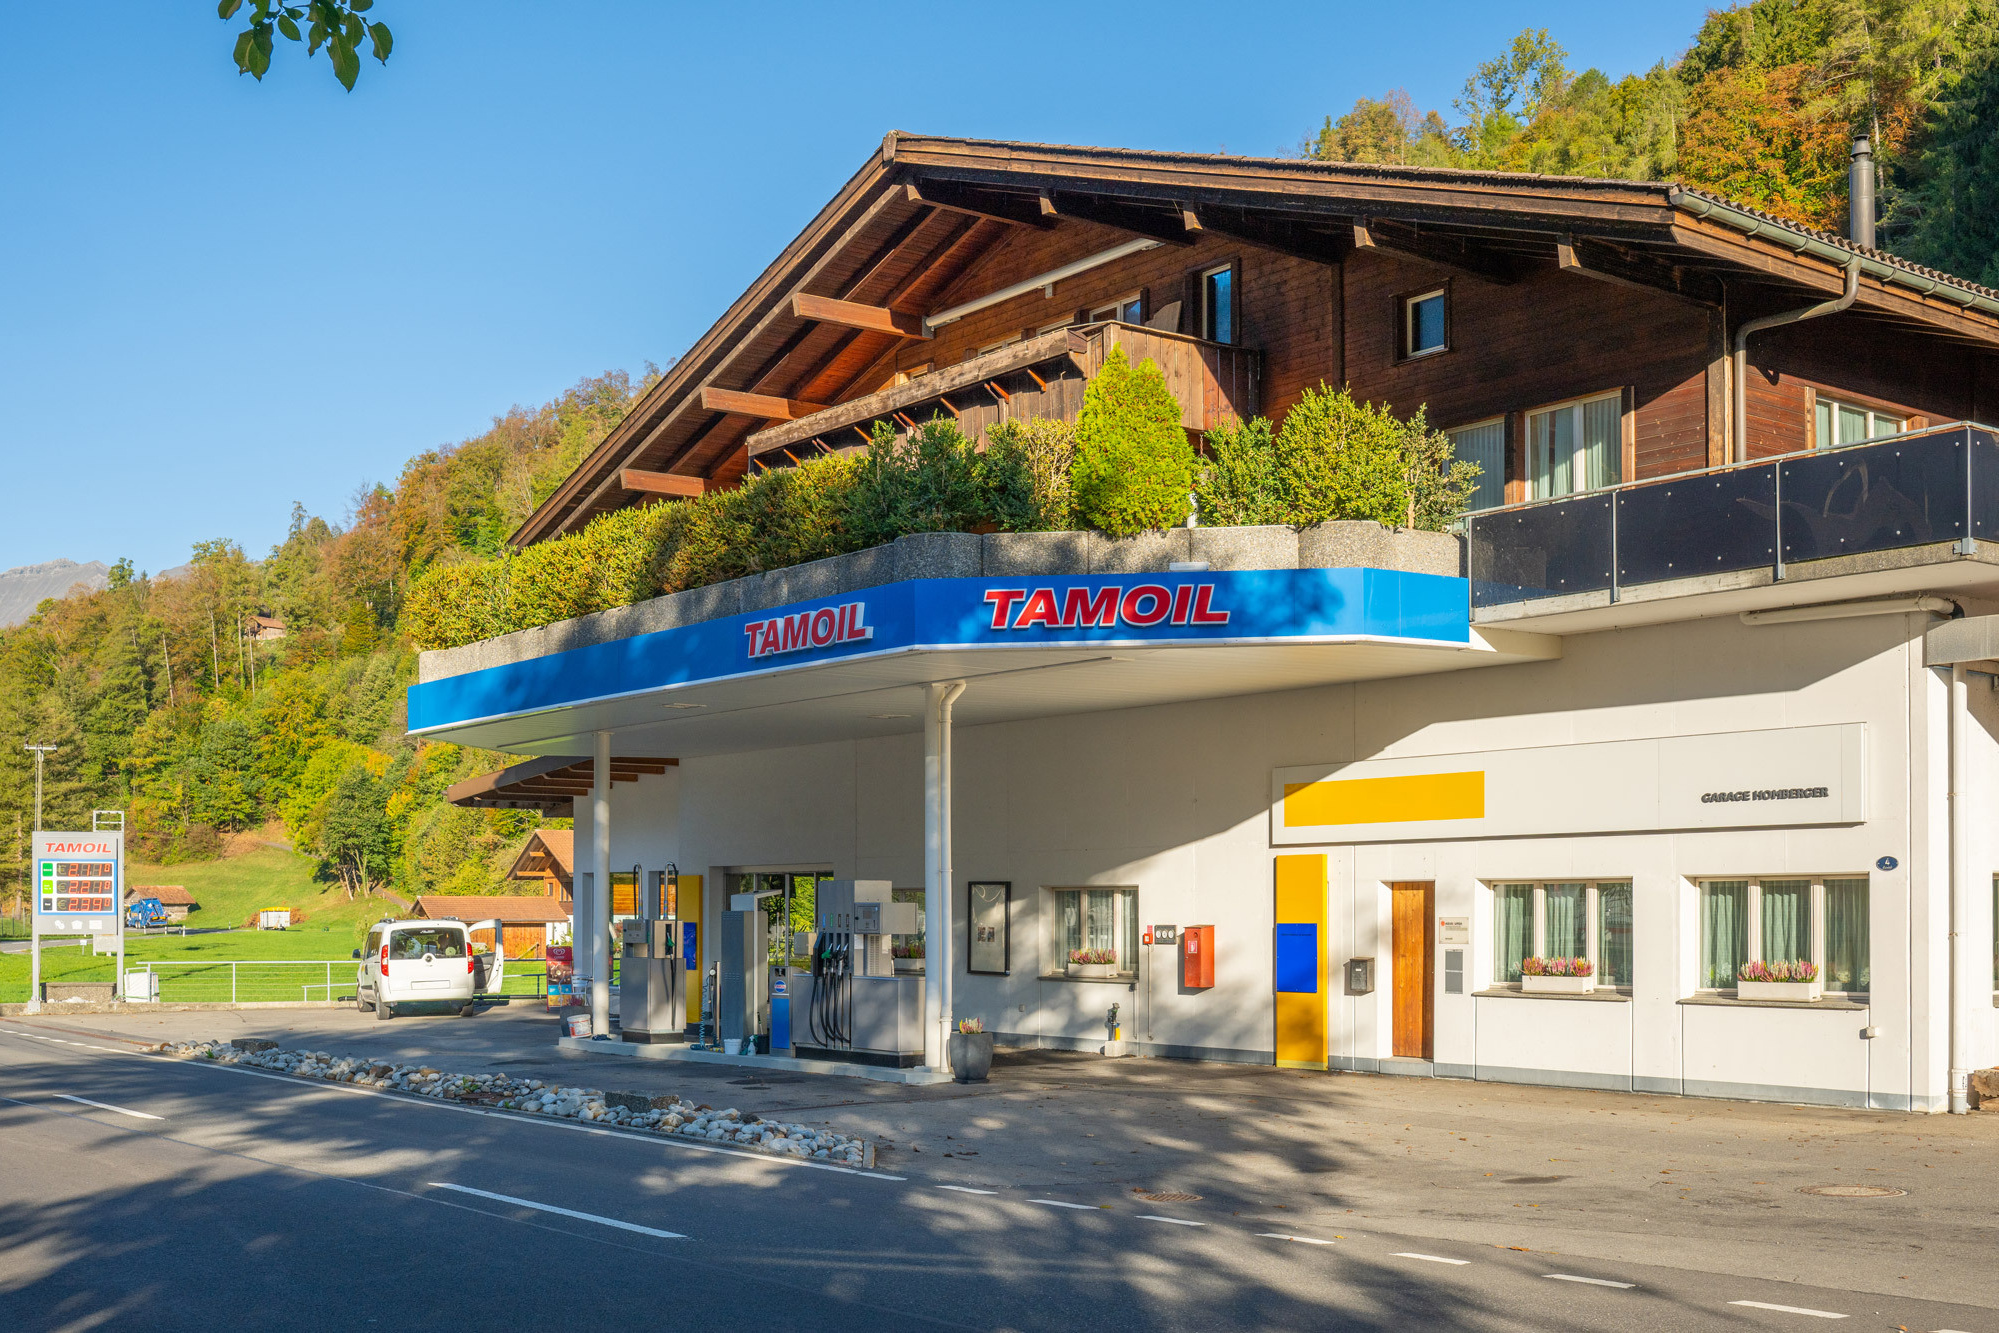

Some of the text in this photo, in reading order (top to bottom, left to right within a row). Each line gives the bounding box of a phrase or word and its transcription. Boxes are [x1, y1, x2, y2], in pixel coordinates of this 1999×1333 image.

[983, 584, 1230, 629] TAMOIL
[744, 602, 873, 658] TAMOIL
[1701, 787, 1829, 803] GARAGE HOMBERGER
[45, 843, 112, 853] TAMOIL
[1885, 857, 1890, 866] 4
